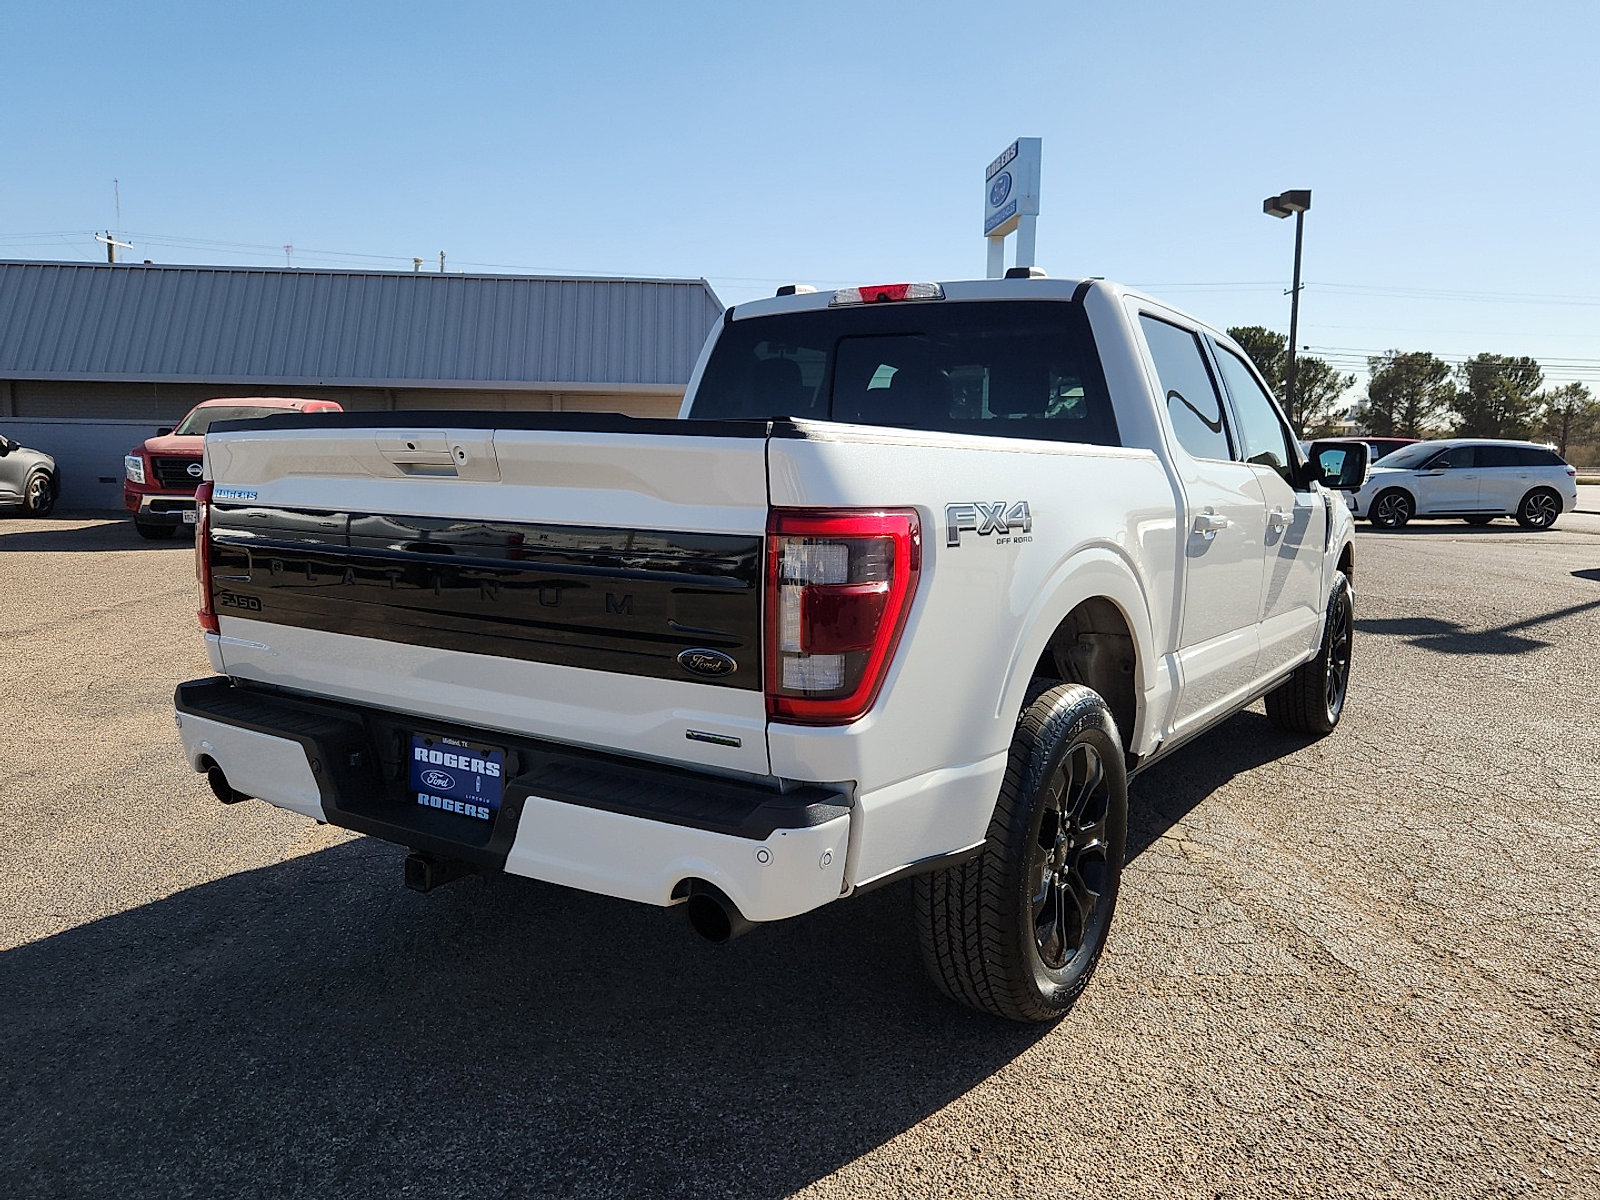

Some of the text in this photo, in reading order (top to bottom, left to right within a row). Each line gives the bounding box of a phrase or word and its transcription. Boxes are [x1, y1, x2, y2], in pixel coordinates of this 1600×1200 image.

[945, 501, 1032, 547] FX4
[270, 558, 633, 616] PLATINUM
[690, 654, 722, 671] Ford
[414, 747, 500, 777] ROGERS
[426, 773, 449, 788] Ford
[417, 793, 490, 820] ROGERS
